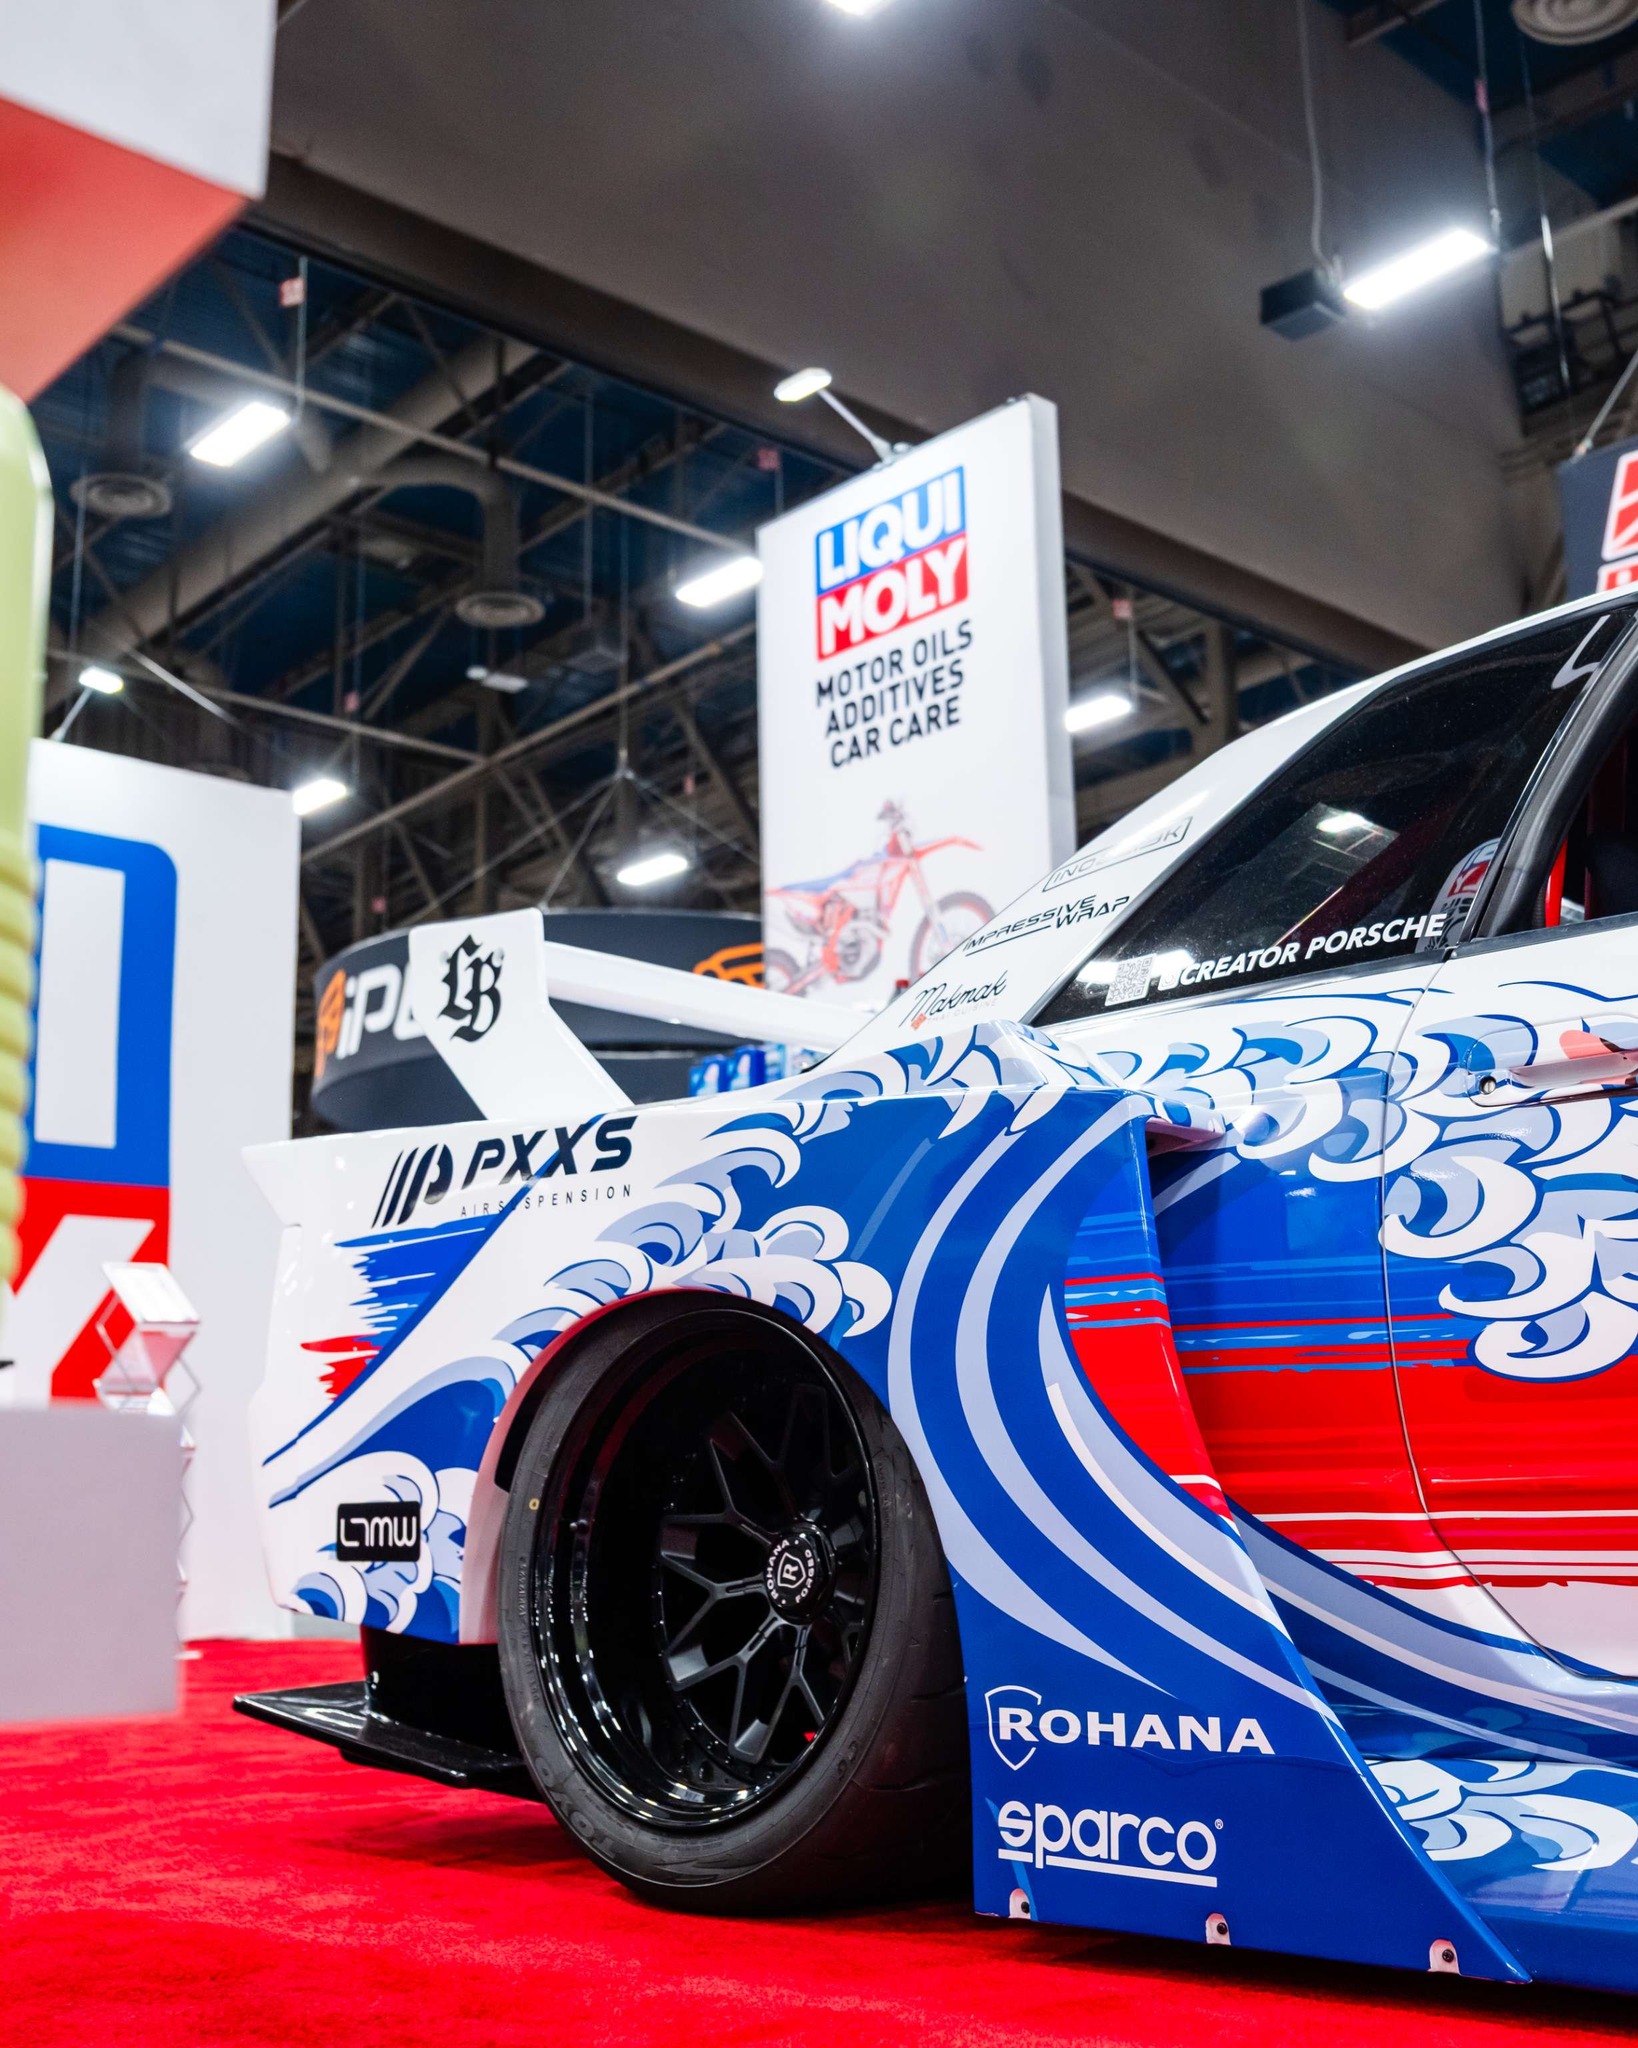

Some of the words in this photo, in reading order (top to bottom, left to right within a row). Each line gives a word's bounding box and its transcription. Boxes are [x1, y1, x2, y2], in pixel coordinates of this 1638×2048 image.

[818, 471, 961, 591] LIQUI
[819, 537, 967, 656] MOLY
[816, 648, 903, 706] MOTOR
[912, 619, 973, 661] OILS
[825, 658, 964, 738] ADDITIVES
[830, 727, 880, 769] CAR
[889, 696, 961, 747] CARE
[1056, 896, 1130, 929] WRAP
[1179, 942, 1300, 985] CREATOR
[1304, 913, 1447, 960] PORSCHE
[461, 1115, 638, 1190] PXXS
[461, 1184, 631, 1217] AIRSSPENSION
[767, 1540, 790, 1599] ROHANA
[782, 1563, 799, 1581] R
[795, 1549, 815, 1603] FORGED
[998, 1706, 1276, 1755] ROHANA
